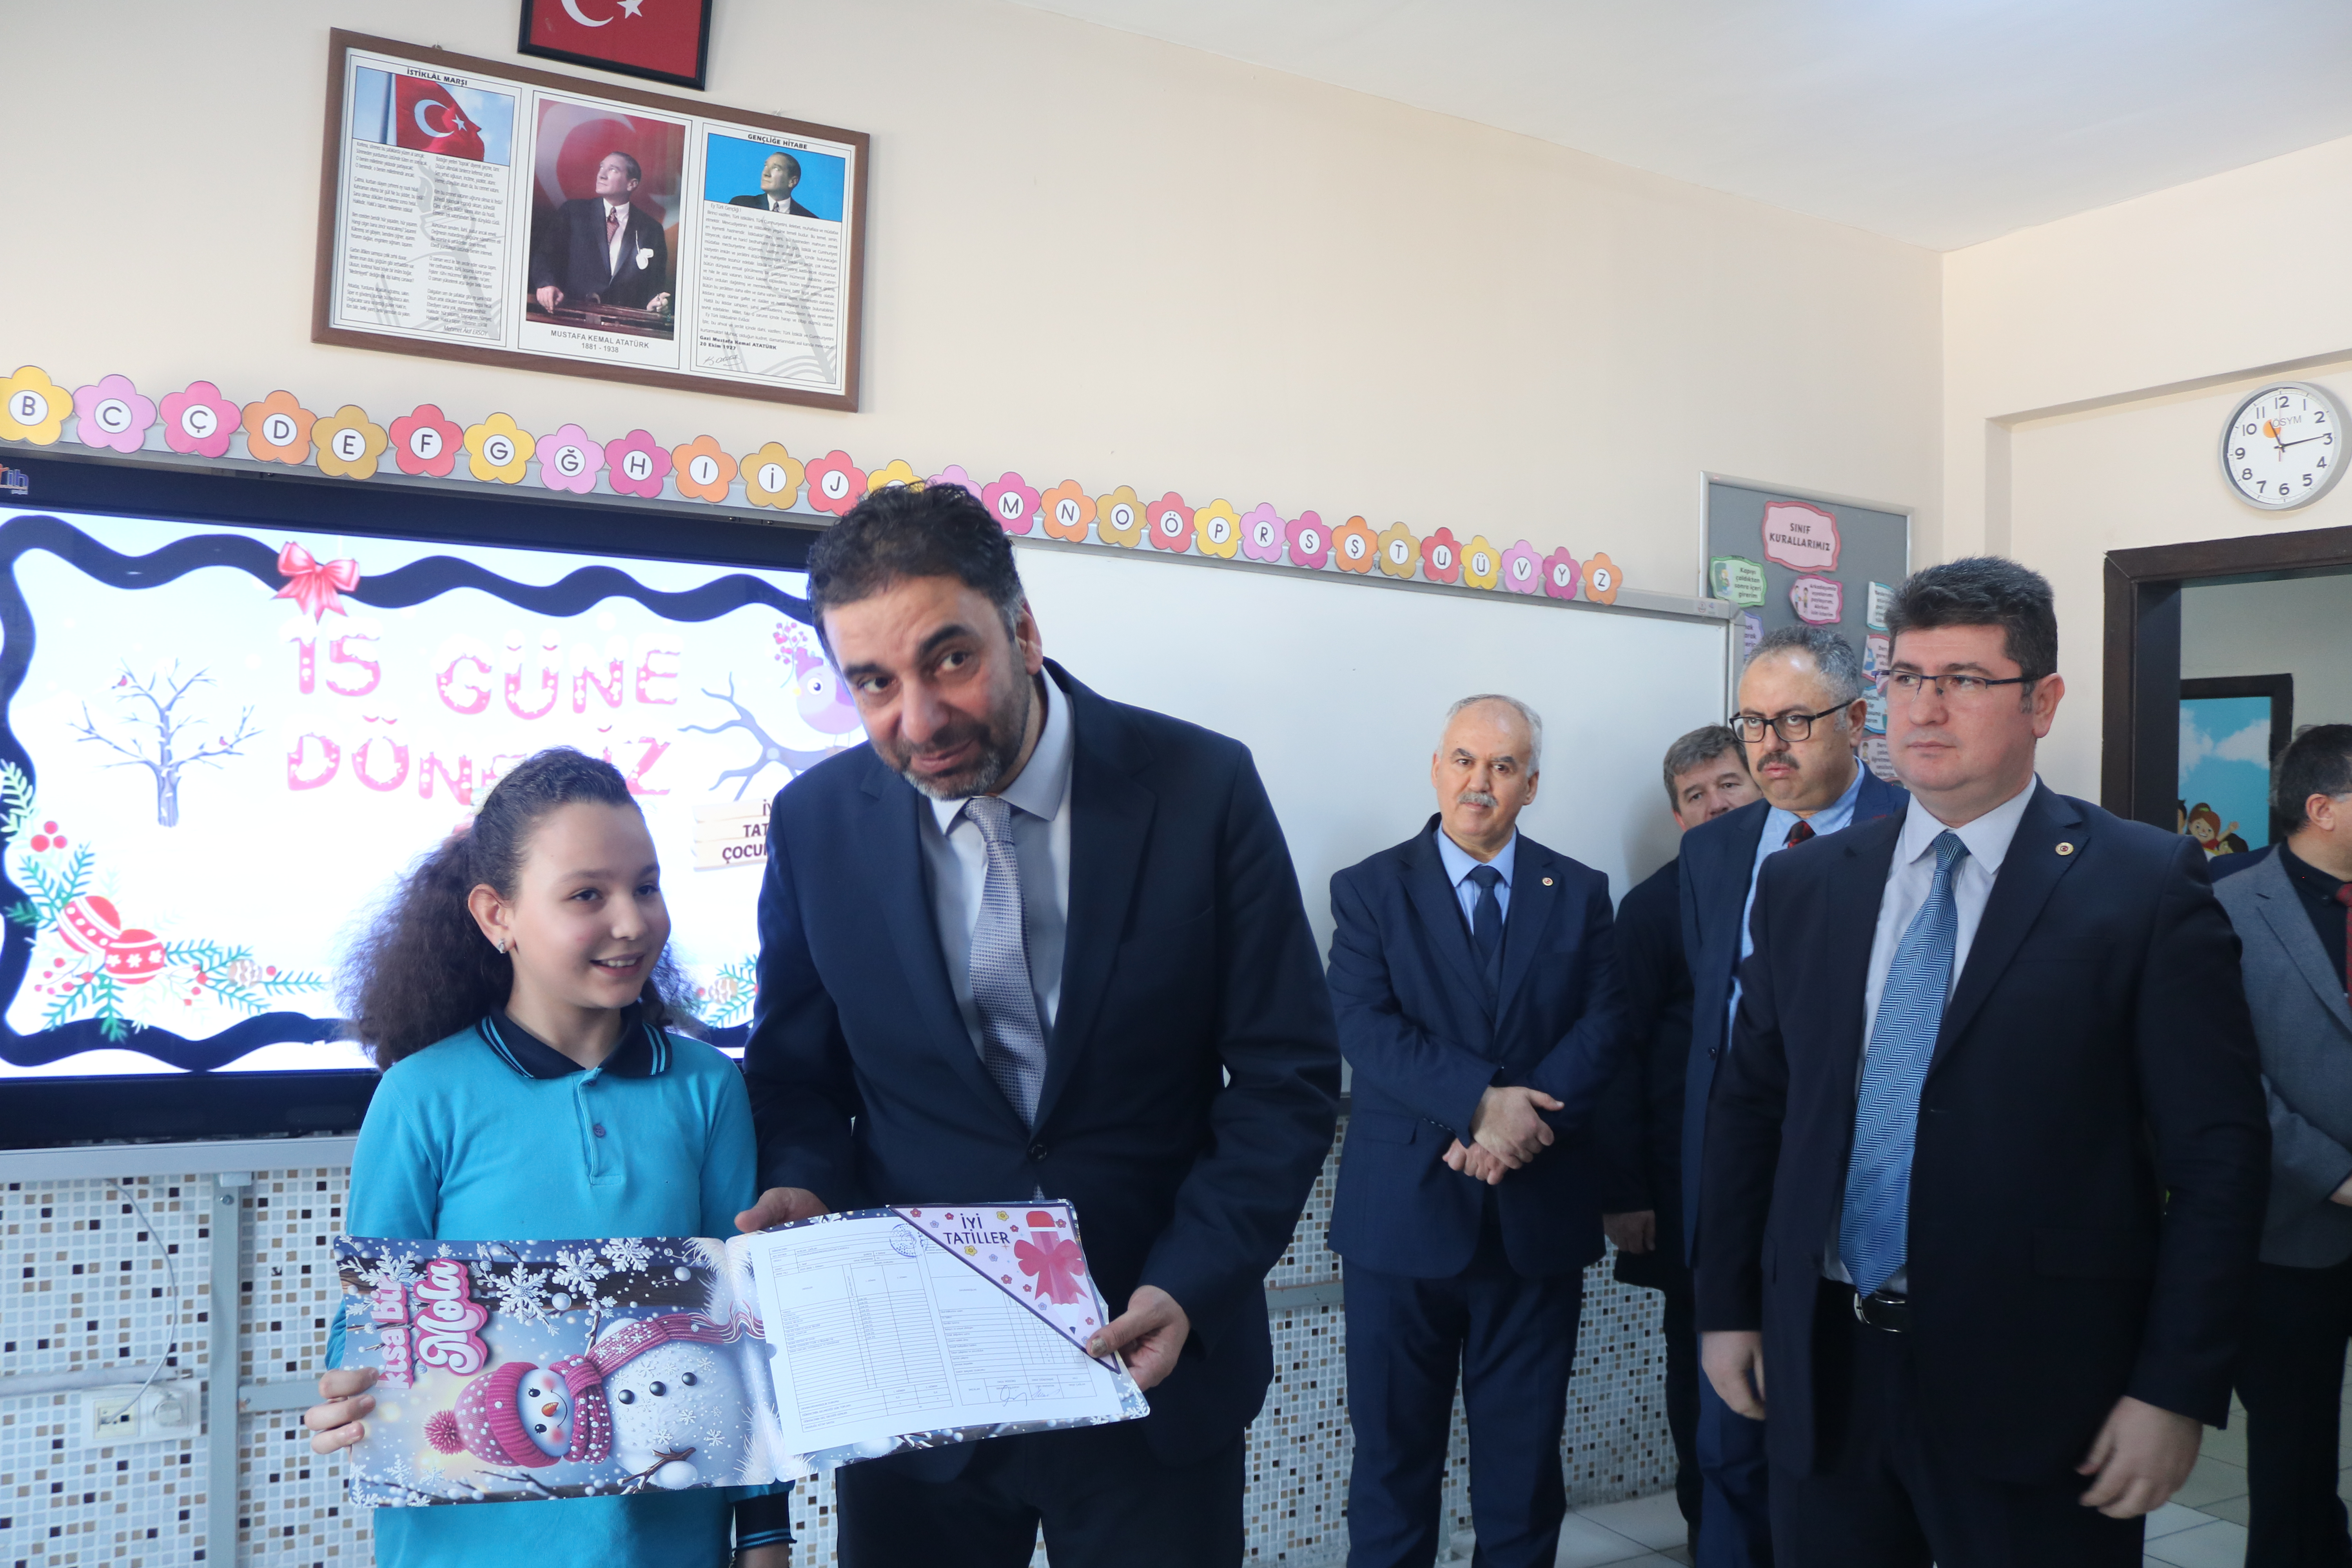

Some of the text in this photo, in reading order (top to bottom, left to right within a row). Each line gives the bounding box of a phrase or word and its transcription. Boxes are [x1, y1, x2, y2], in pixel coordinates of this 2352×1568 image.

[407, 68, 468, 87] İSTİKLÂL MARŞI
[748, 133, 808, 149] GENÇLİĞE HİTABE
[551, 330, 649, 349] MUSTAFA KEMAL ATATÜRK
[2275, 396, 2289, 409] 12
[2256, 406, 2265, 419] 11
[2314, 411, 2325, 424] 2
[2273, 415, 2302, 428] ÖSYM
[2242, 423, 2257, 436] 10
[2323, 433, 2333, 445] 3
[2235, 447, 2245, 459] 9
[2316, 456, 2327, 468] 4
[2242, 468, 2252, 480] 8
[2303, 474, 2312, 487] 5
[22, 396, 35, 417] B
[103, 407, 122, 426] C
[190, 410, 207, 434] Ç
[274, 421, 289, 439] D
[343, 436, 356, 455] E
[421, 435, 433, 453] F
[490, 442, 508, 460] G
[561, 449, 579, 471] Ğ
[630, 456, 645, 475] H
[830, 476, 840, 492] J
[1003, 497, 1019, 514] M
[1062, 504, 1074, 521] N
[1115, 510, 1129, 525] O
[1165, 513, 1178, 533] Ö
[1215, 523, 1223, 539] P
[1260, 526, 1268, 542] R
[1305, 534, 1313, 549] S
[1351, 540, 1359, 559] Ş
[1396, 545, 1403, 559] T
[1518, 562, 1527, 575] V
[1558, 568, 1567, 581] Y
[1597, 573, 1606, 587] Z
[2256, 481, 2267, 494] 7
[2279, 483, 2290, 495] 6
[1790, 523, 1811, 534] SINIF
[1769, 532, 1831, 552] KURALLARIMIZ
[287, 629, 681, 720] 15 GÜNE
[961, 1212, 983, 1229] İYİ
[943, 1229, 1011, 1245] TATİLLER
[370, 1275, 409, 1323] bir
[416, 1259, 481, 1375] Mola
